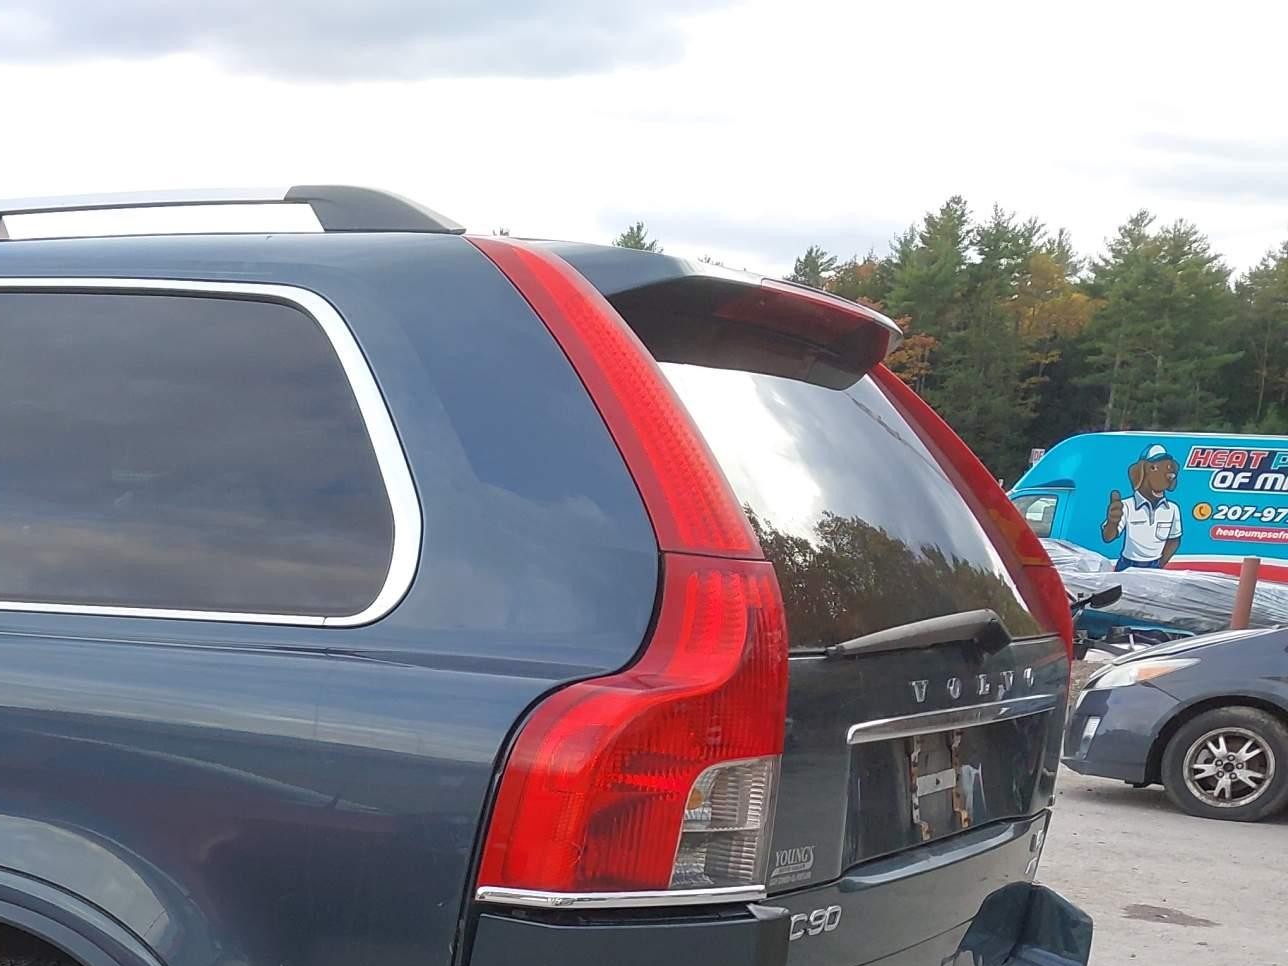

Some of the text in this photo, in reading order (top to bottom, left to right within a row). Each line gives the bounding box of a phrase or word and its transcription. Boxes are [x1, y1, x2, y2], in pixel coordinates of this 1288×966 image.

[1188, 448, 1268, 469] HEAT
[1213, 471, 1252, 489] OF
[1213, 505, 1288, 523] 207-97
[909, 667, 1035, 703] VOLVO
[789, 905, 842, 941] C90
